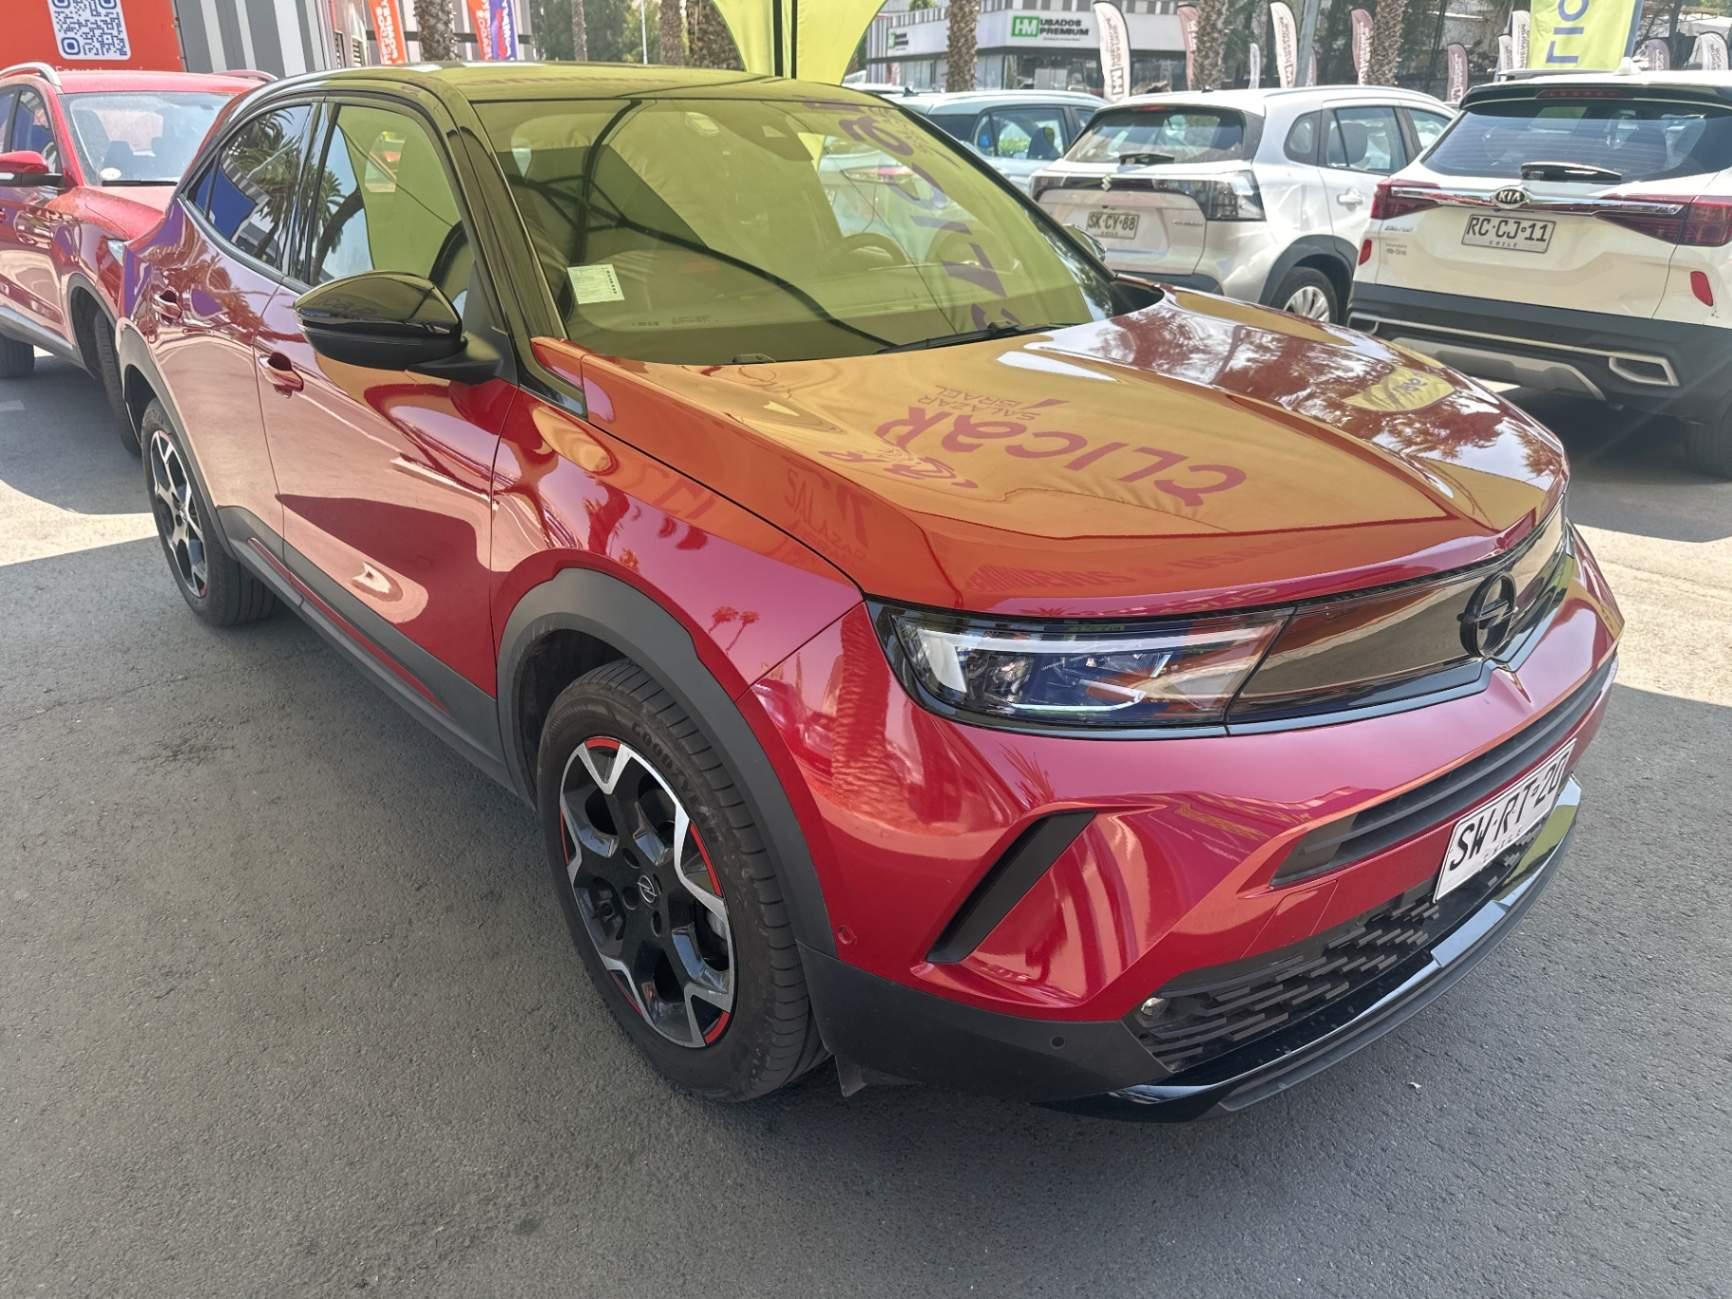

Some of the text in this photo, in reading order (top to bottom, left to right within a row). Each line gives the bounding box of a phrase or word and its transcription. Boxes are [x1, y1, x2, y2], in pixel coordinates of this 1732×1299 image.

[1040, 18, 1081, 27] USADOS
[1040, 28, 1089, 36] PREMIUM
[1498, 191, 1521, 203] KIA
